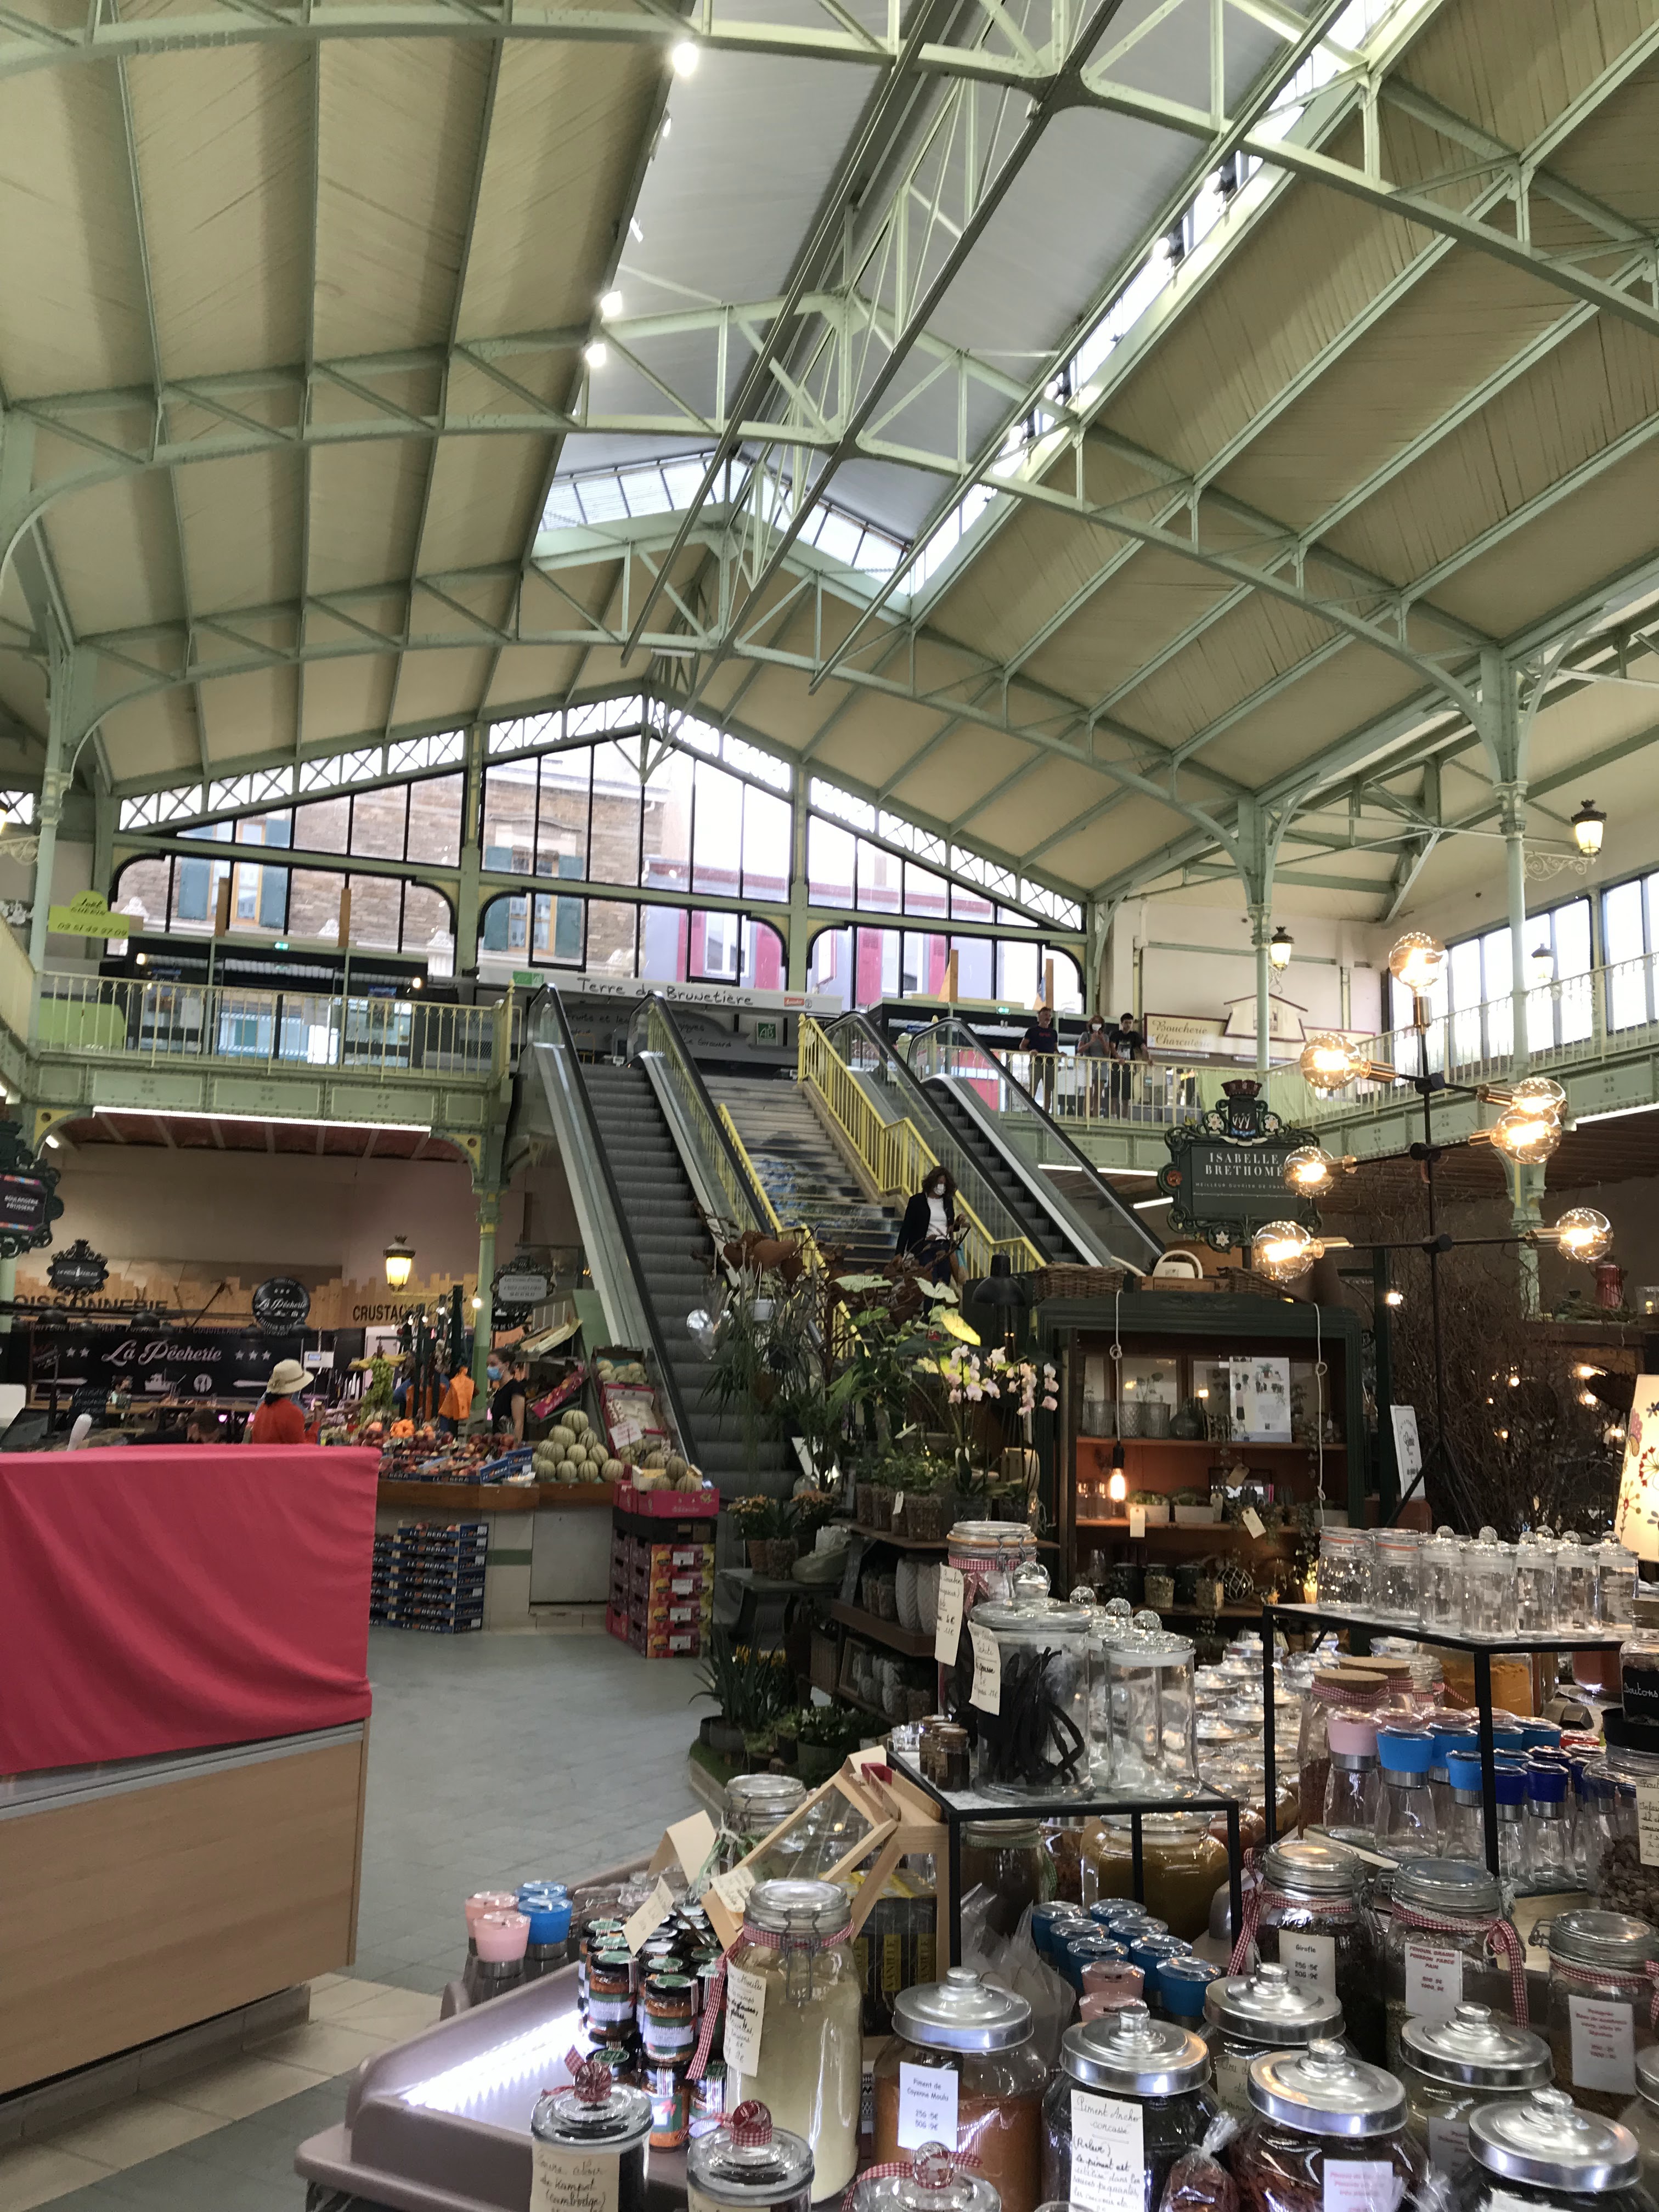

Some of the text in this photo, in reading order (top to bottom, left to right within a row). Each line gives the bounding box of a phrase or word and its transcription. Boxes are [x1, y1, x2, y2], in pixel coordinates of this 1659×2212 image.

[577, 977, 754, 1006] Terre de Brunetière
[1153, 1019, 1207, 1035] Boucherie
[1155, 1034, 1211, 1047] Charcuterie
[1210, 1152, 1279, 1165] ISABELLE
[1205, 1164, 1284, 1177] BRETHOMÉ
[101, 1339, 222, 1367] La Pêcherie
[1296, 1944, 1316, 1953] Girofle
[913, 2078, 932, 2088] Piment
[907, 2087, 949, 2102] Cayenne Moulu
[1075, 2095, 1108, 2117] Piment
[915, 2119, 927, 2129] 50G
